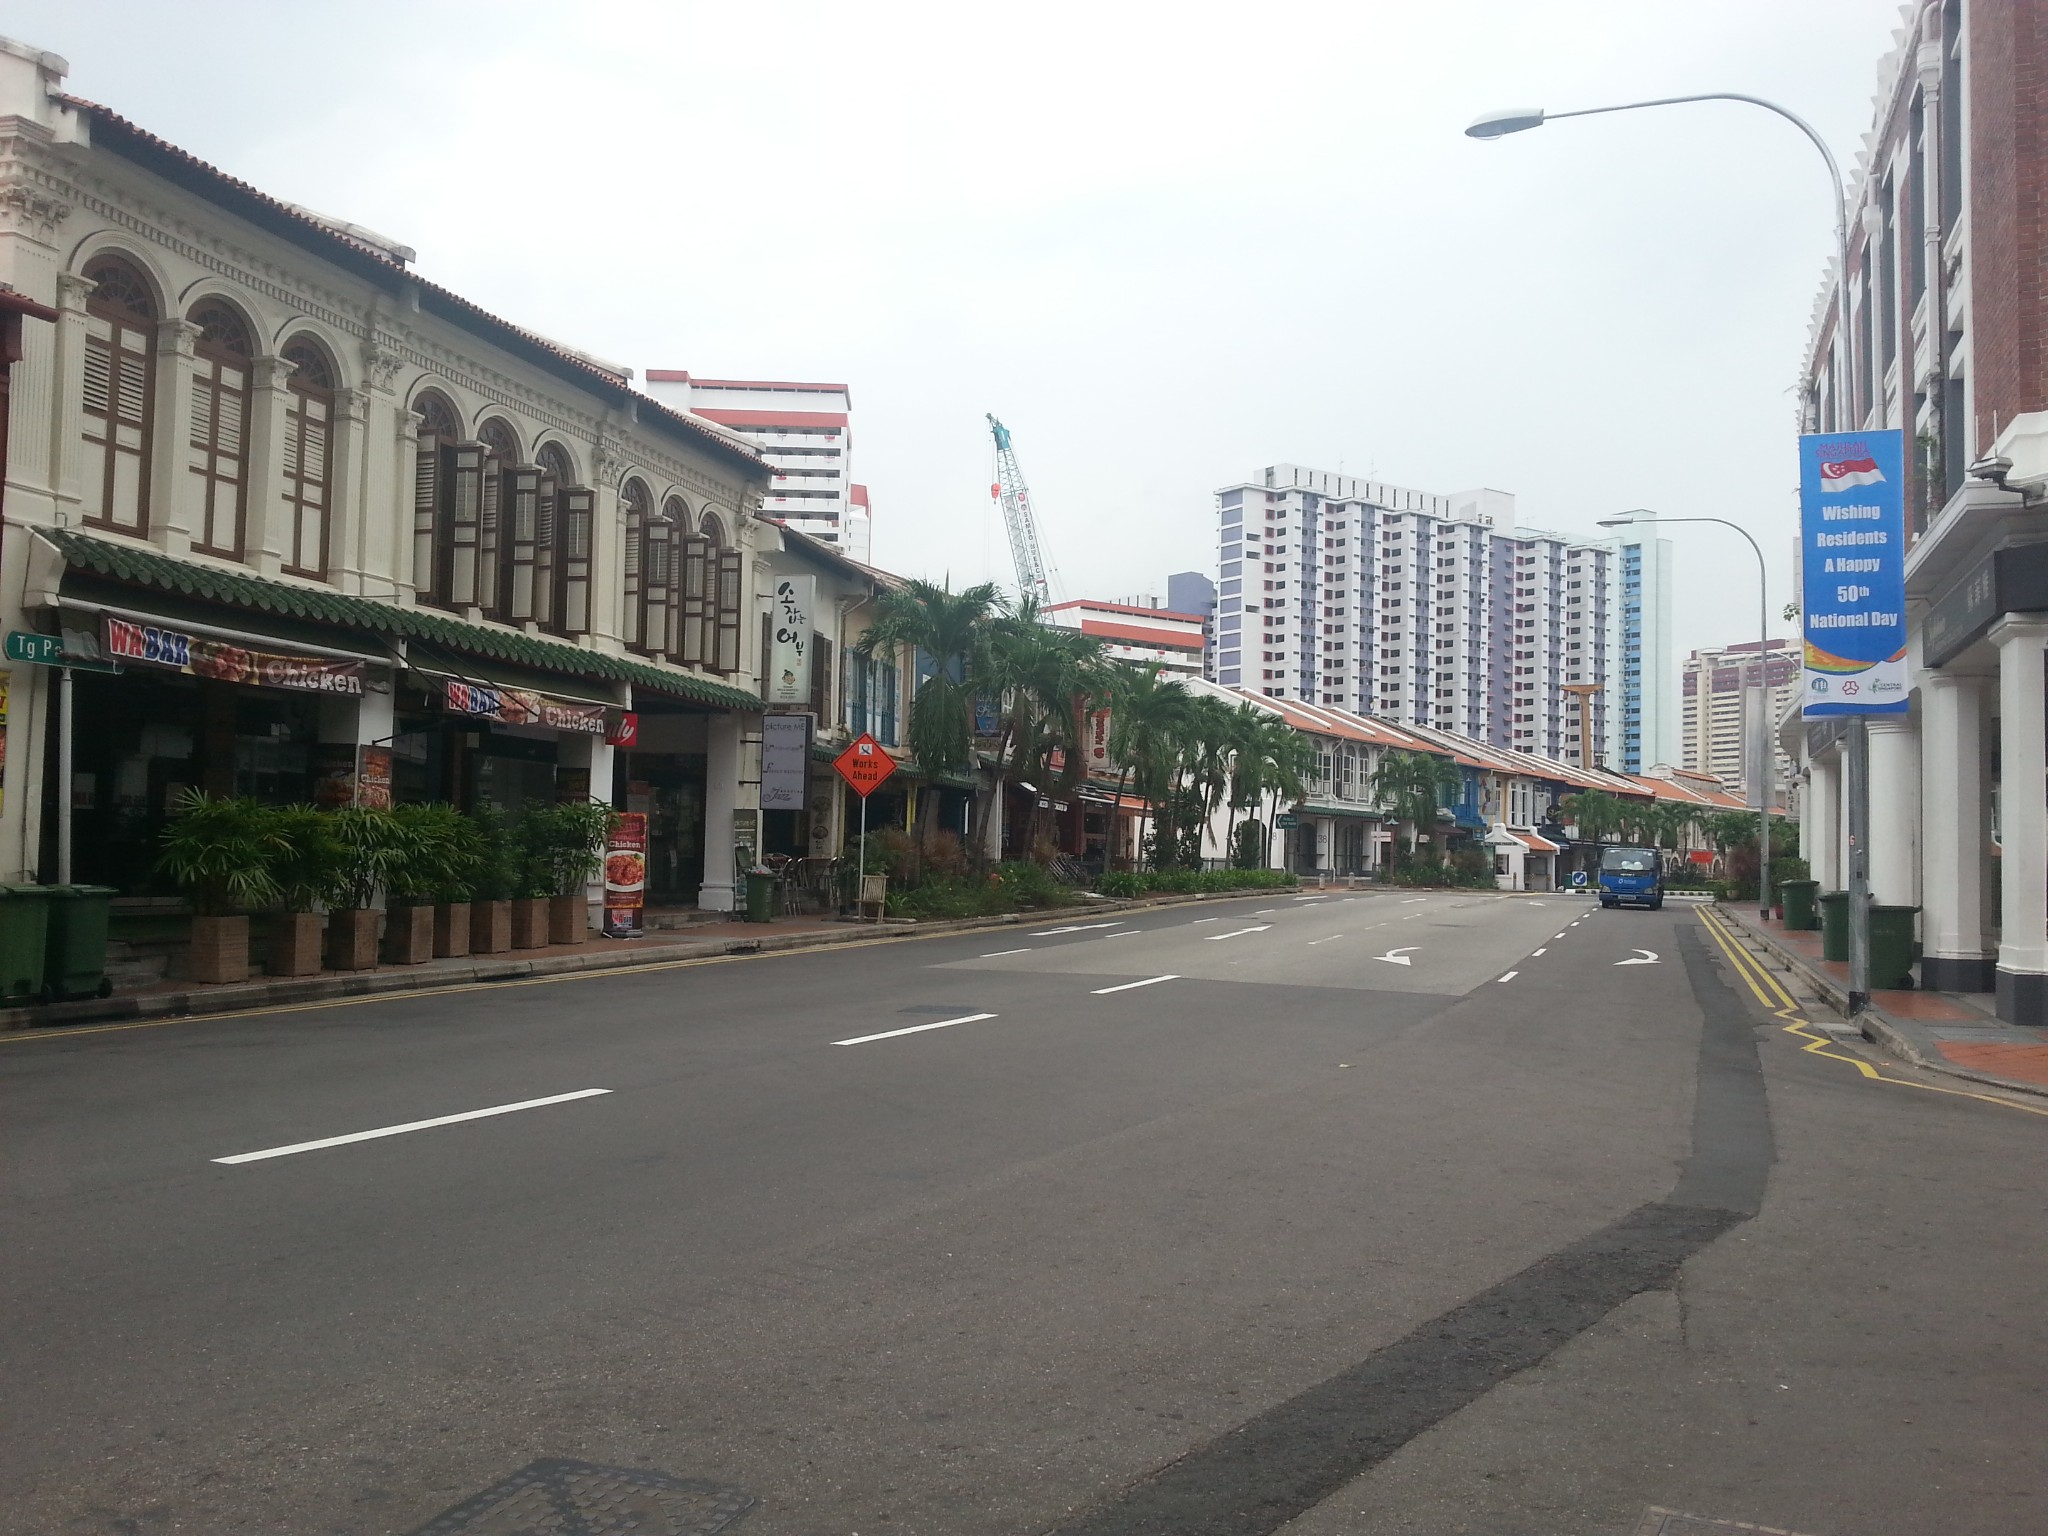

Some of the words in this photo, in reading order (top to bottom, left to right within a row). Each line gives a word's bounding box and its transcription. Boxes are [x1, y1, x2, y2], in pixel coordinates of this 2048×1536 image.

[1822, 505, 1880, 520] Wishing
[1817, 530, 1887, 547] Residents
[1824, 558, 1834, 572] A
[1837, 557, 1880, 572] Happy
[1837, 585, 1870, 602] 50th
[1810, 612, 1868, 628] National
[1871, 611, 1898, 627] Day
[17, 635, 35, 659] Tg
[266, 660, 362, 694] Chicken
[545, 707, 605, 734] Chicken
[765, 722, 793, 731] picture
[852, 758, 879, 769] Works
[360, 773, 390, 785] Chicken
[852, 770, 878, 781] Ahead
[608, 840, 641, 849] Chicken
[1318, 835, 1327, 843] 38
[1849, 835, 1855, 846] 6
